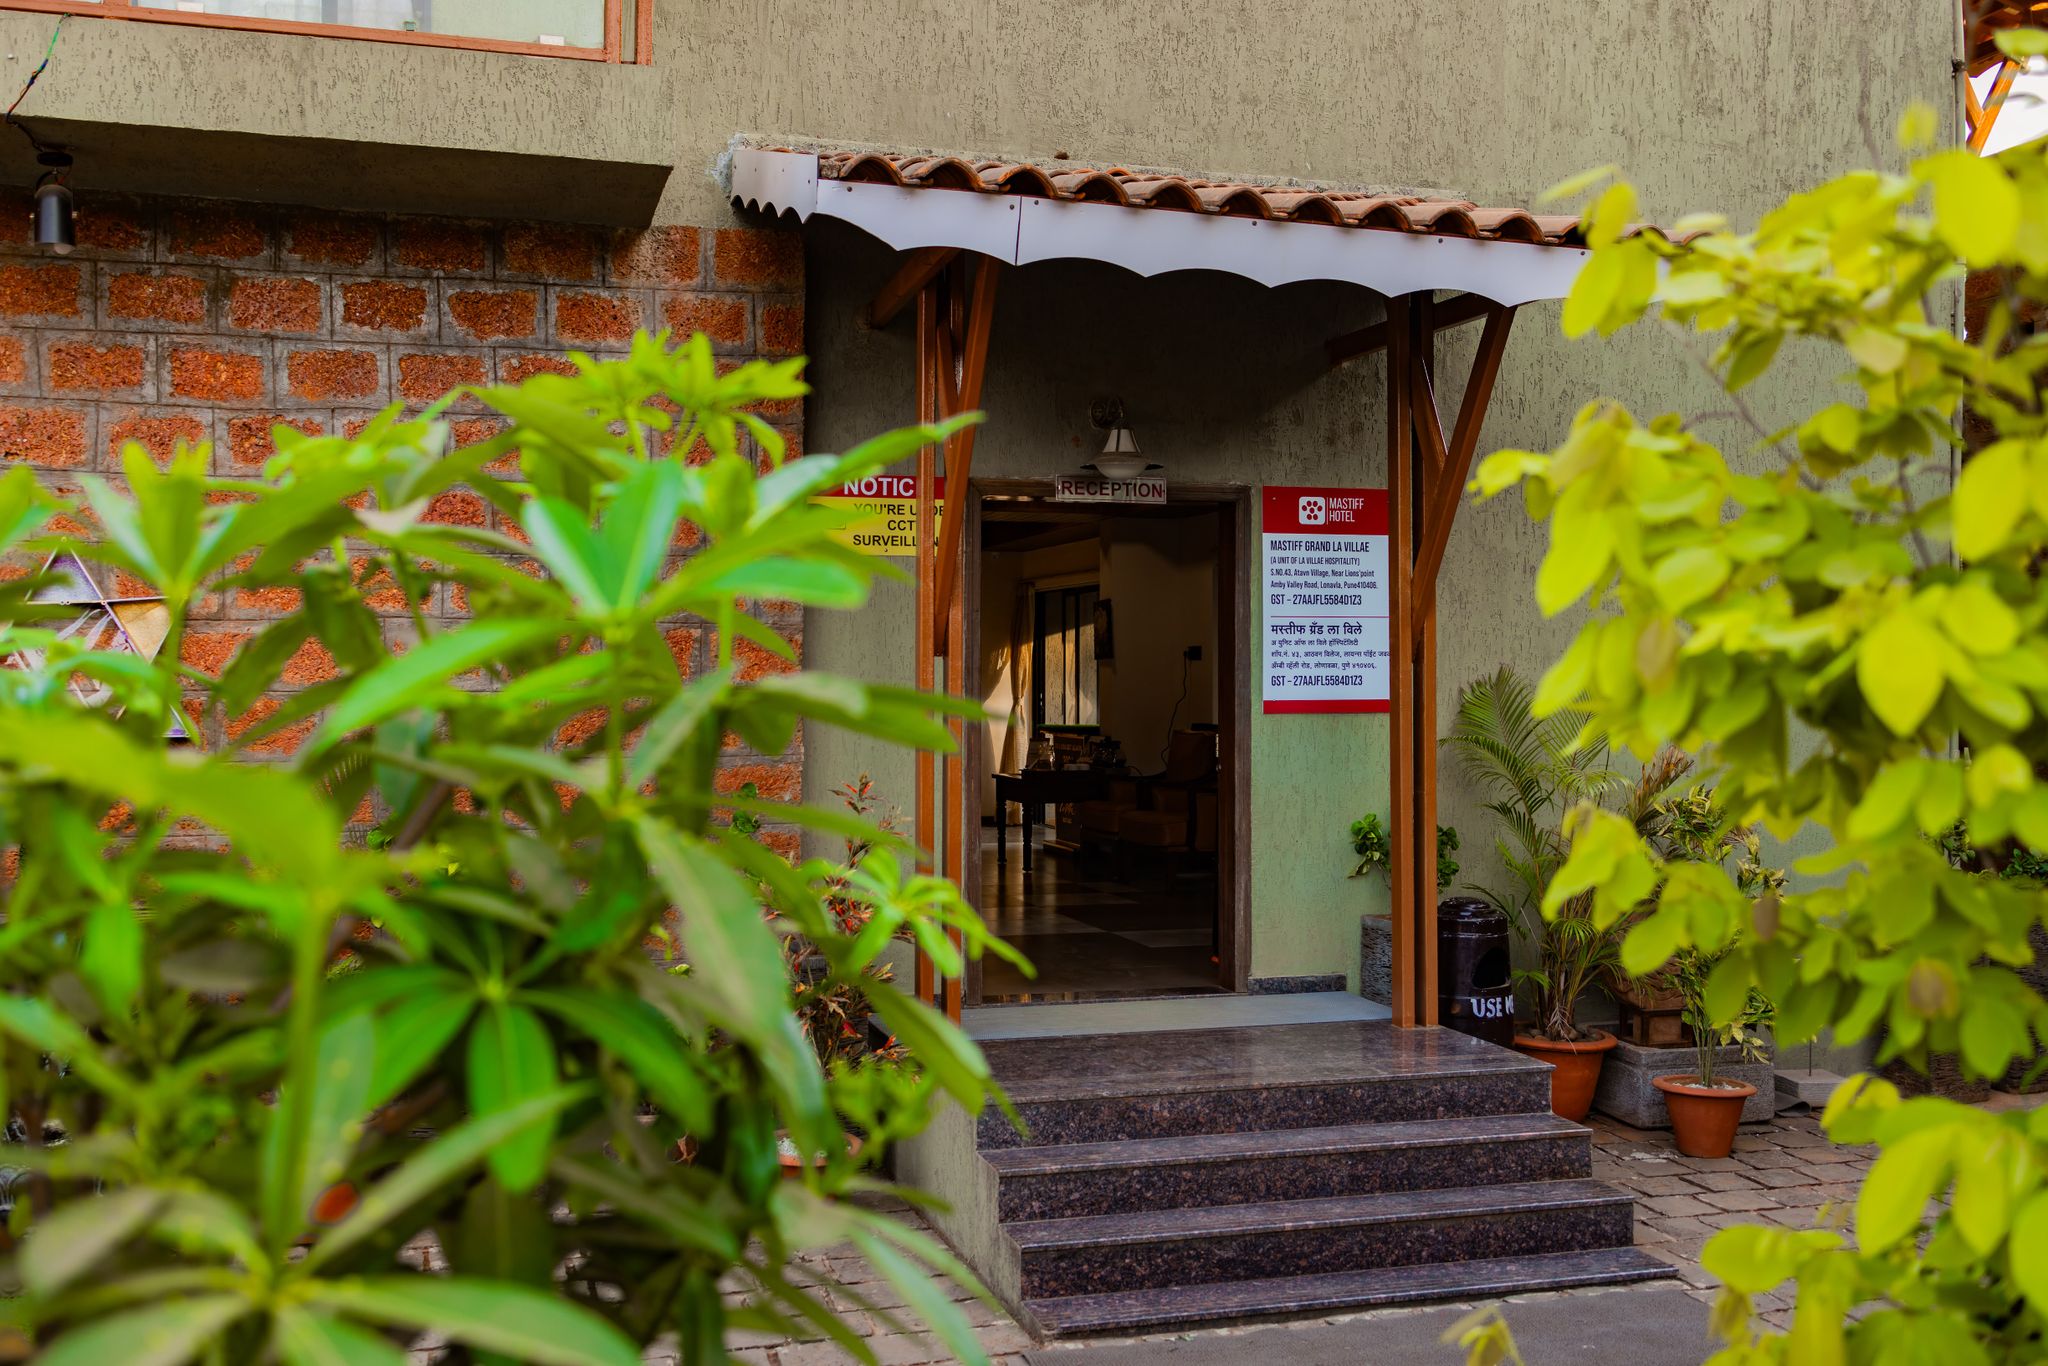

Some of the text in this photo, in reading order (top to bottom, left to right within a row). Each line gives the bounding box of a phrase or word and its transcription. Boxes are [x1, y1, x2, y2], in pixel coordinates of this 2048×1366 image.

[844, 477, 914, 497] NOTIC
[1061, 480, 1163, 498] RECEPTION
[1329, 497, 1364, 510] MASTIFF
[1329, 510, 1355, 522] HOTEL
[887, 519, 916, 531] CCT
[1270, 540, 1369, 553] MASTIFF GRAND LA VILLAE
[1278, 556, 1290, 565] UNIT
[1290, 556, 1298, 565] OF
[1298, 556, 1305, 565] LA
[1306, 557, 1324, 565] VILLAE
[1325, 557, 1360, 566] HOSPITALITY)
[1331, 569, 1344, 578] Near
[1270, 580, 1286, 590] Amby
[1287, 580, 1304, 590] Valley
[1271, 593, 1285, 605] GST
[1270, 621, 1306, 635] मस्तीफ
[1327, 624, 1340, 635] ला
[1343, 621, 1363, 635] विले
[1271, 675, 1286, 686] GST
[1470, 997, 1503, 1018] USE
